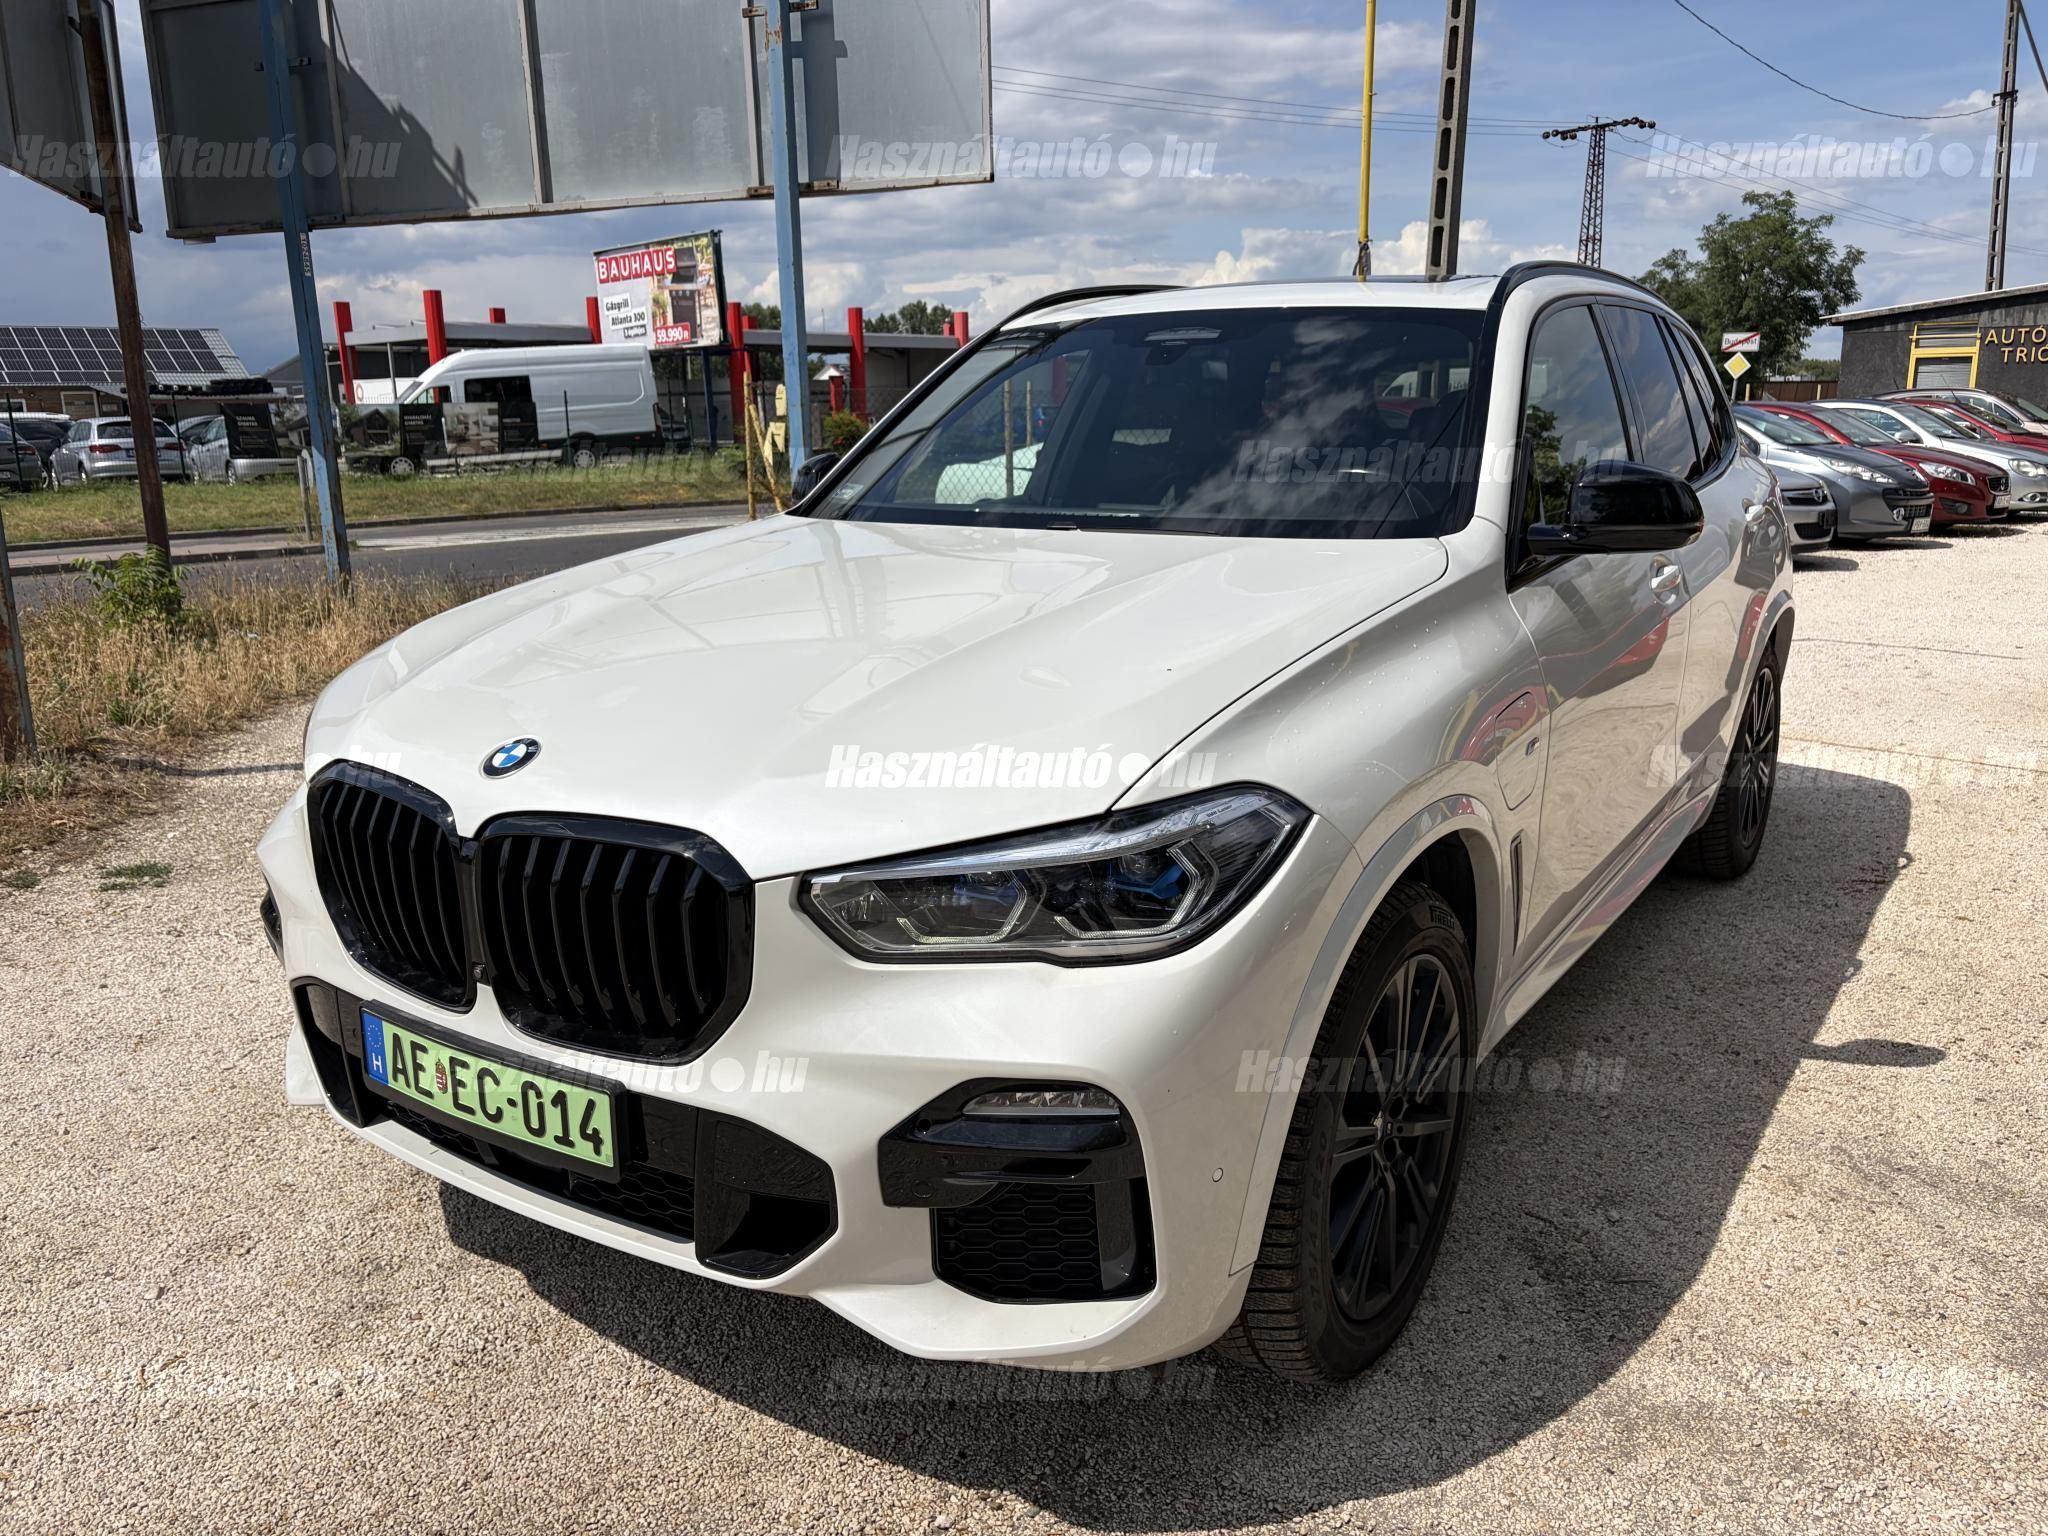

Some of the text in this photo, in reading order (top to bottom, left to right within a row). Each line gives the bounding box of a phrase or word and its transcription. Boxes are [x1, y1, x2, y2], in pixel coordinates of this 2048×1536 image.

[598, 250, 676, 280] BAUHAUS
[605, 299, 630, 312] Gázgrill
[611, 312, 646, 326] Atlanta 300
[656, 326, 683, 343] 59.990
[1984, 324, 2047, 345] AUTÓ
[371, 1053, 383, 1074] H
